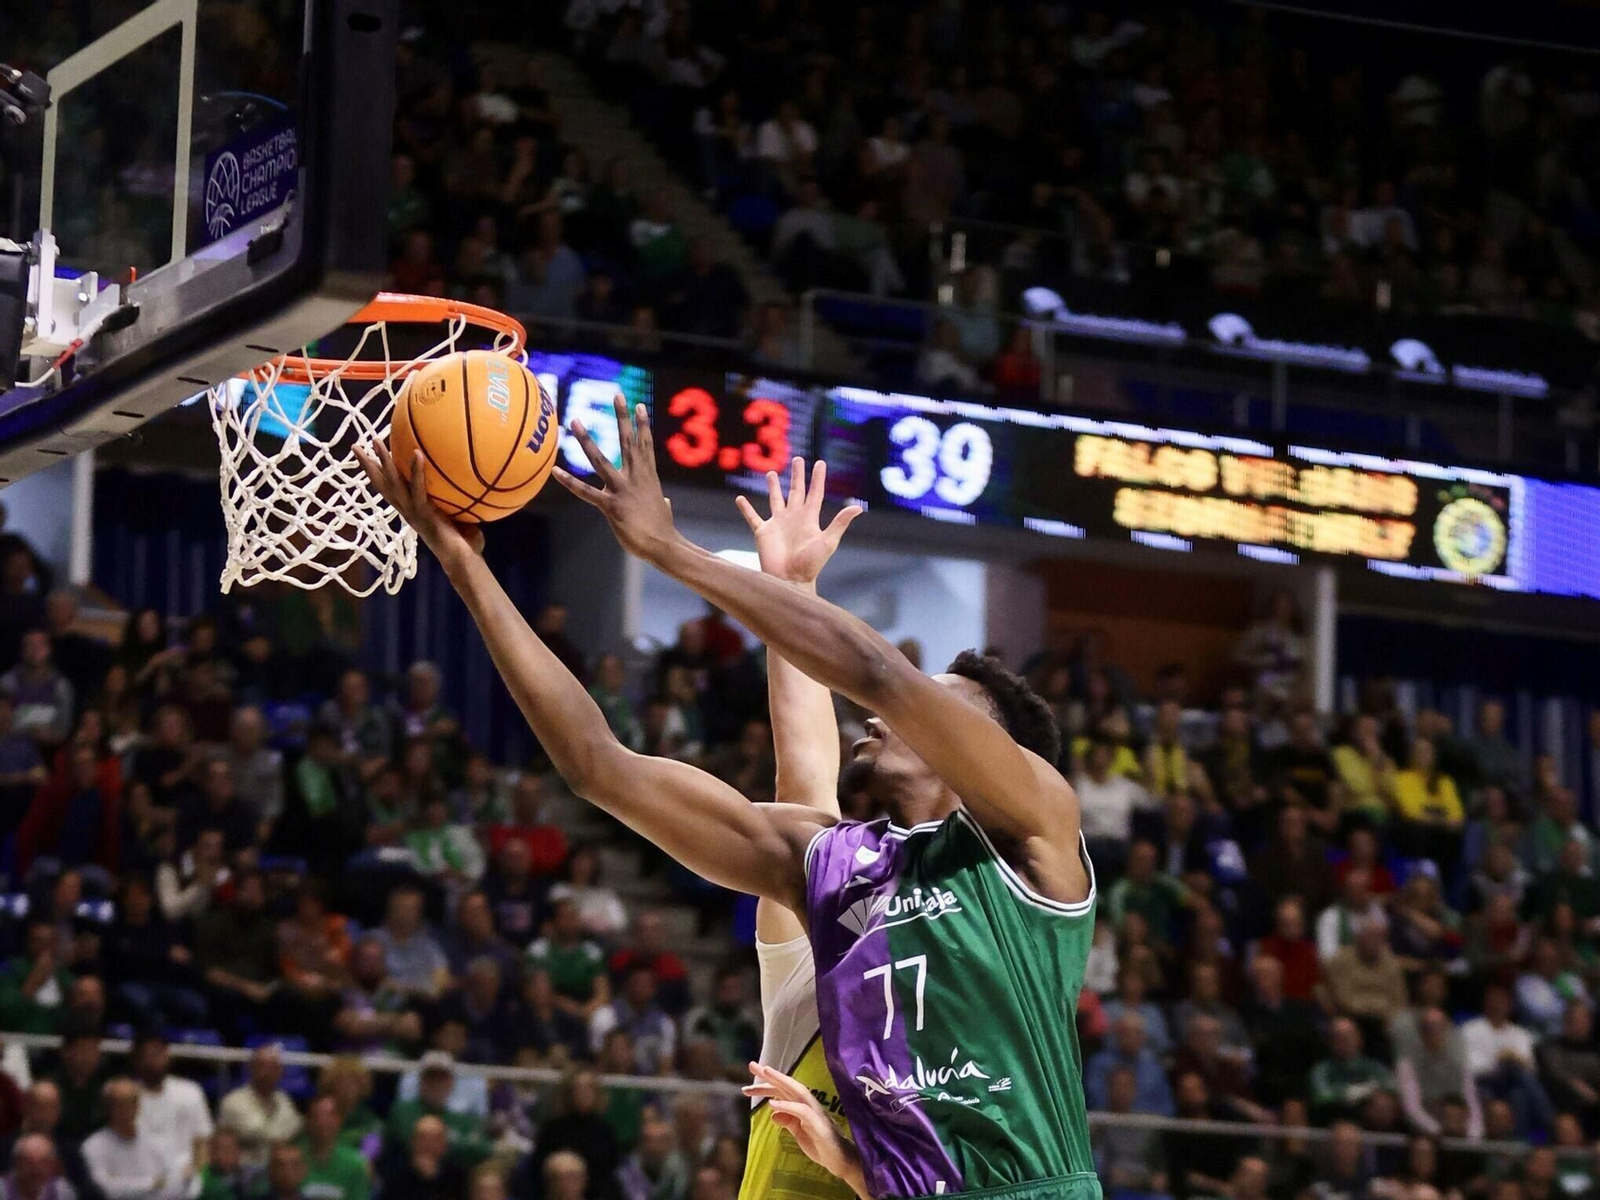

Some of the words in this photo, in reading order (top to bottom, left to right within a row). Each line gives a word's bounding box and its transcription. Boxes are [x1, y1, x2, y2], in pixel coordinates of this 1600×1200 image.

[241, 181, 279, 215] LEAGUE
[666, 386, 791, 473] 3.3
[880, 416, 993, 506] 39
[884, 887, 958, 917] Uniaja
[863, 954, 928, 1040] 77
